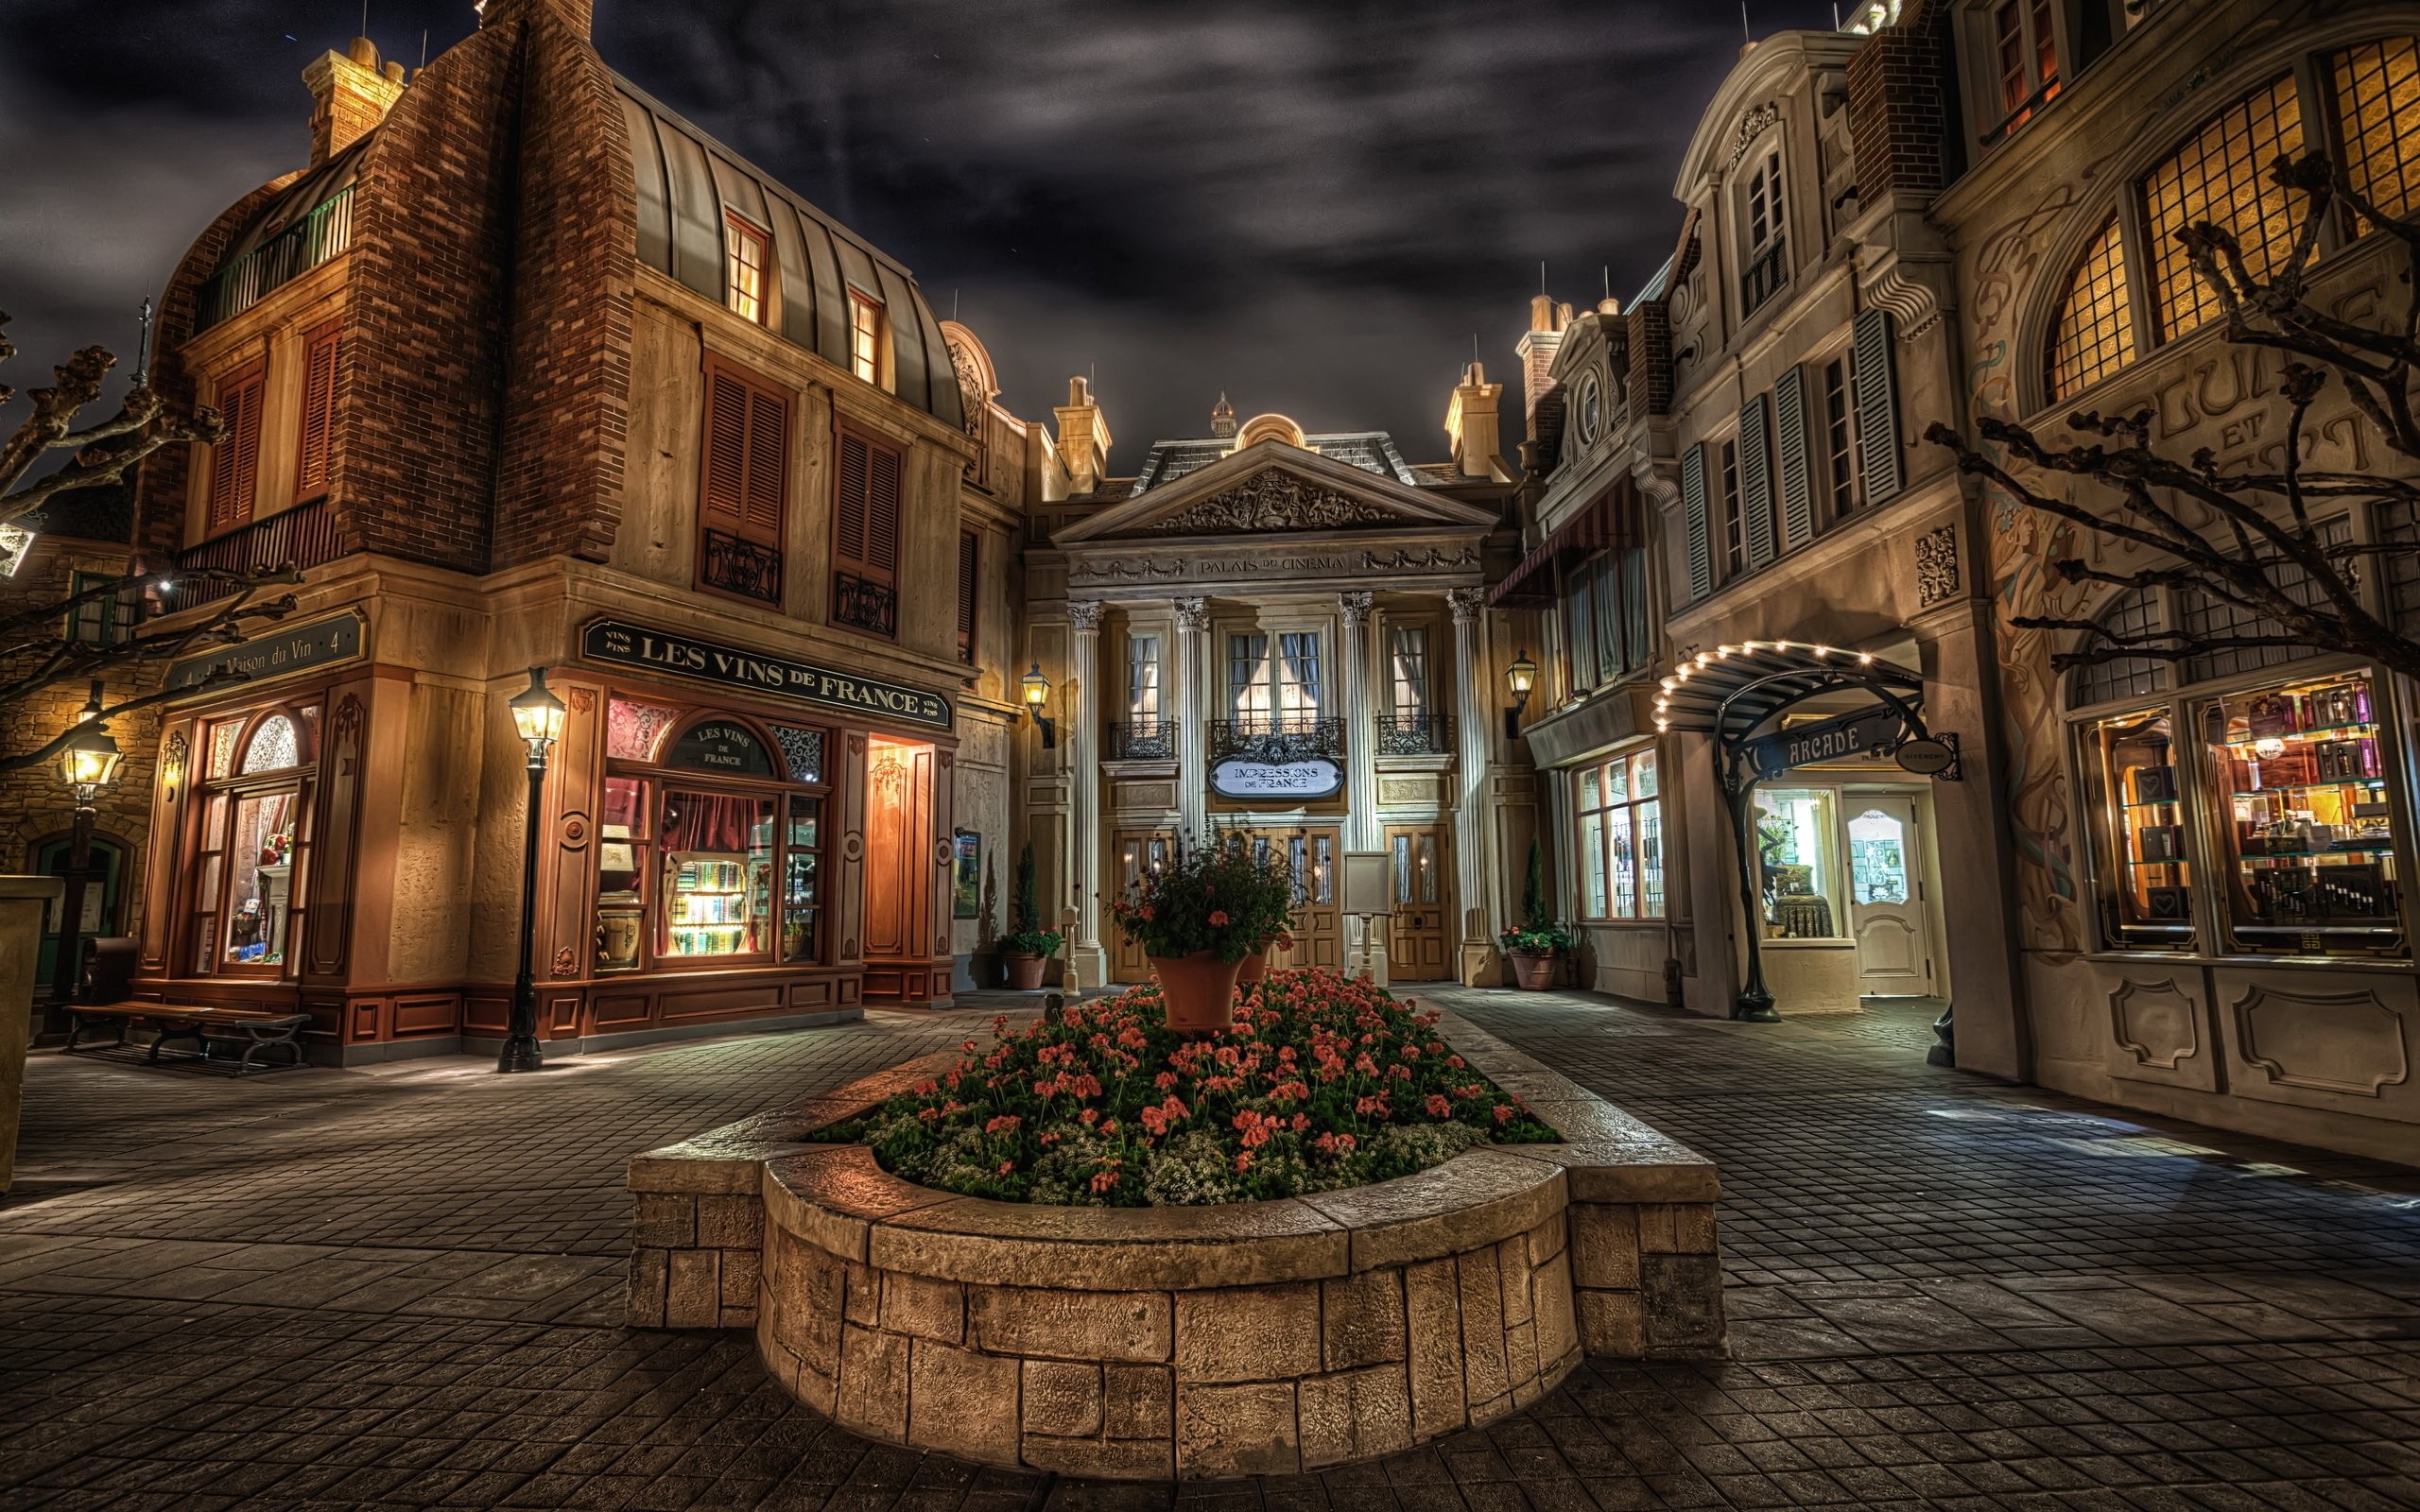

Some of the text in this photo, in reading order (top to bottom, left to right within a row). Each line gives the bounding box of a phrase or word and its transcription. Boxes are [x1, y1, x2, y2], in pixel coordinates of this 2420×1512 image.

[2221, 410, 2267, 450] ET
[1201, 560, 1258, 573] PALAIS
[1282, 558, 1344, 570] CINEMA
[605, 631, 631, 644] VINS
[271, 645, 286, 665] du
[291, 639, 312, 660] Vin
[330, 631, 339, 653] 4
[605, 641, 631, 654] FINS
[641, 637, 919, 713] LES VINS DE FRANCE
[923, 699, 939, 710] VINS
[697, 728, 751, 747] LES VINS
[718, 745, 729, 753] DE
[1789, 727, 1859, 765] ARCADE
[704, 753, 741, 766] FRANCE
[1235, 767, 1319, 779] IMPRESSIONS
[1258, 778, 1308, 788] FRANCE
